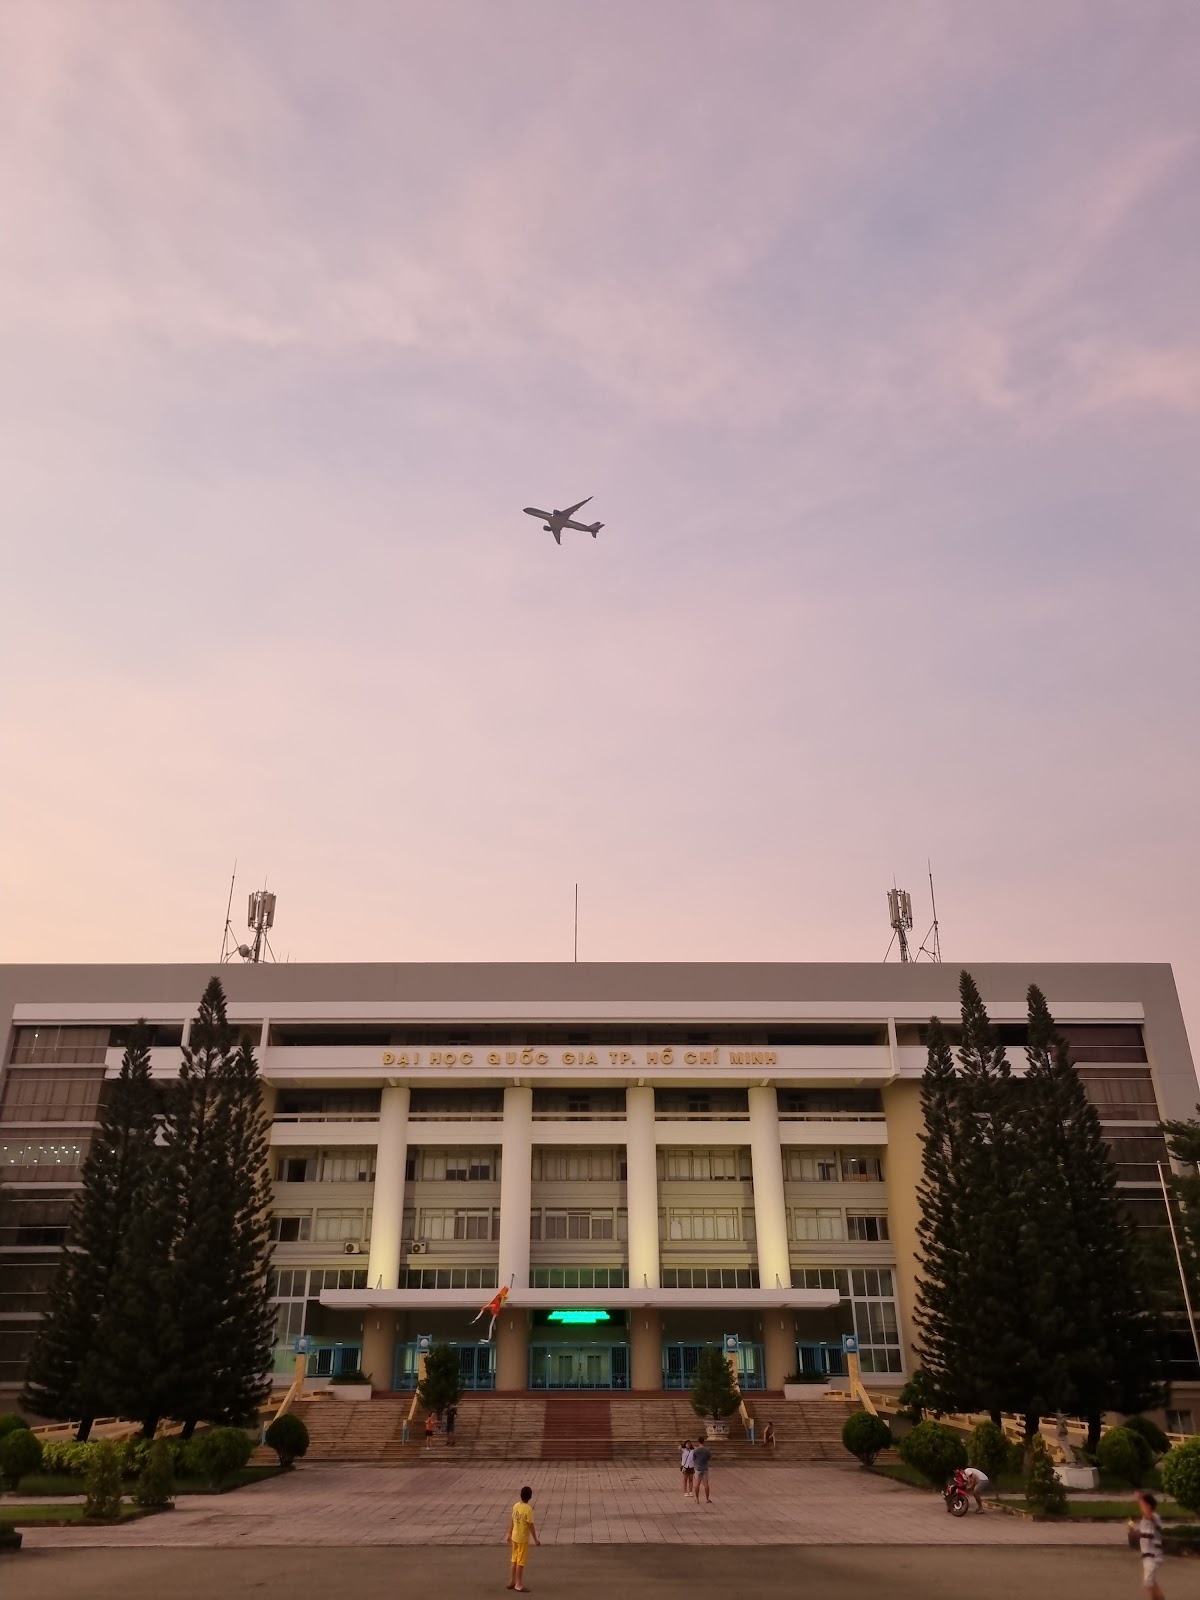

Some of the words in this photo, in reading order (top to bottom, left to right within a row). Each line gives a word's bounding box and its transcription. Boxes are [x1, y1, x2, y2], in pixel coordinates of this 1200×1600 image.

[382, 1051, 419, 1067] ĐẠI
[429, 1051, 473, 1067] HỌC
[487, 1047, 548, 1065] QUỐC
[561, 1051, 598, 1065] GIA
[609, 1051, 636, 1065] TP.
[684, 1046, 719, 1065] CHÍ
[729, 1051, 777, 1065] MINH
